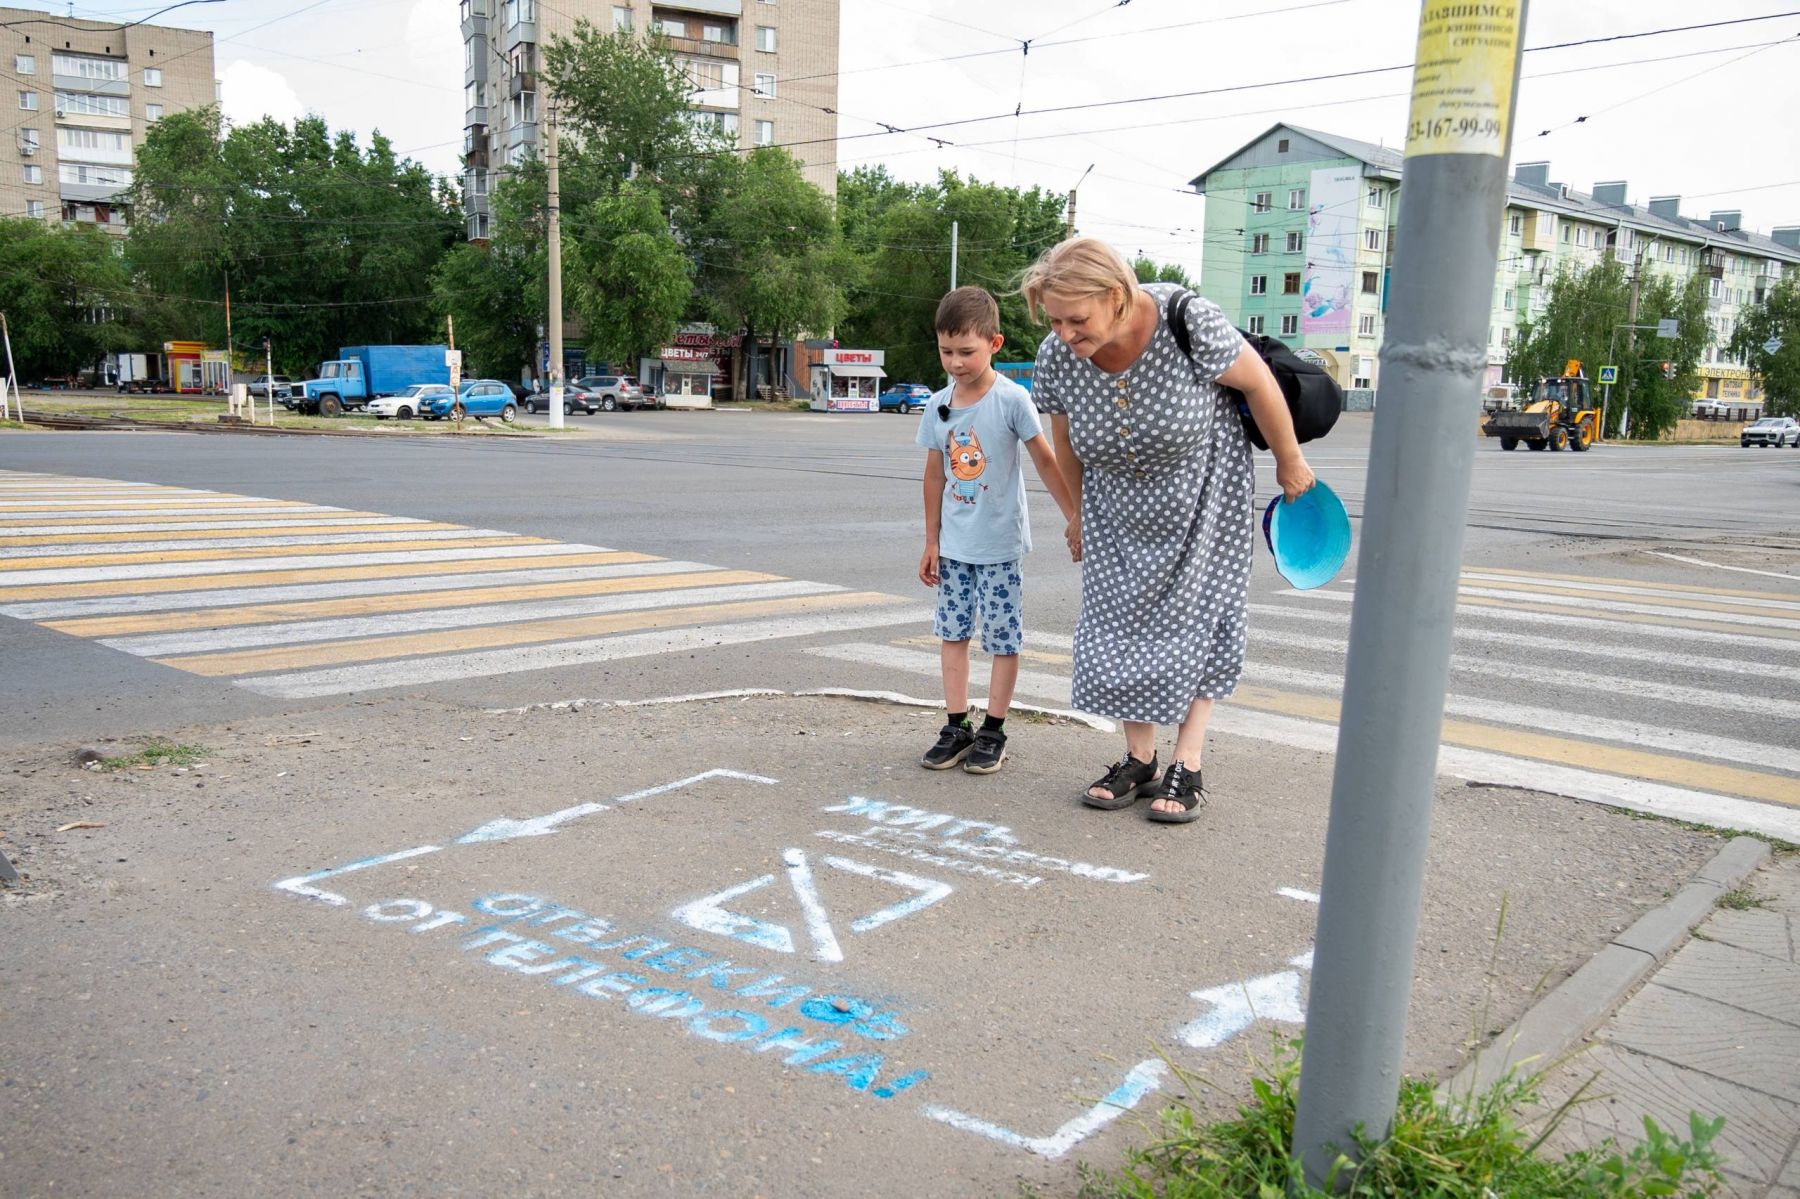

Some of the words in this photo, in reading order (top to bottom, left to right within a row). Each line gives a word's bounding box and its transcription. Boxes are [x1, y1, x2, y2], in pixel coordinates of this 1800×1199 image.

[661, 347, 693, 359] ЦВЕТЫ
[835, 352, 872, 364] ЦВЕТЫ
[822, 795, 1018, 846] ЖИТЬ
[472, 891, 912, 1041] ОТВЛЕКИСЬ
[363, 897, 470, 934] ОТ
[462, 924, 930, 1098] ТЕЛЕФОНА!
